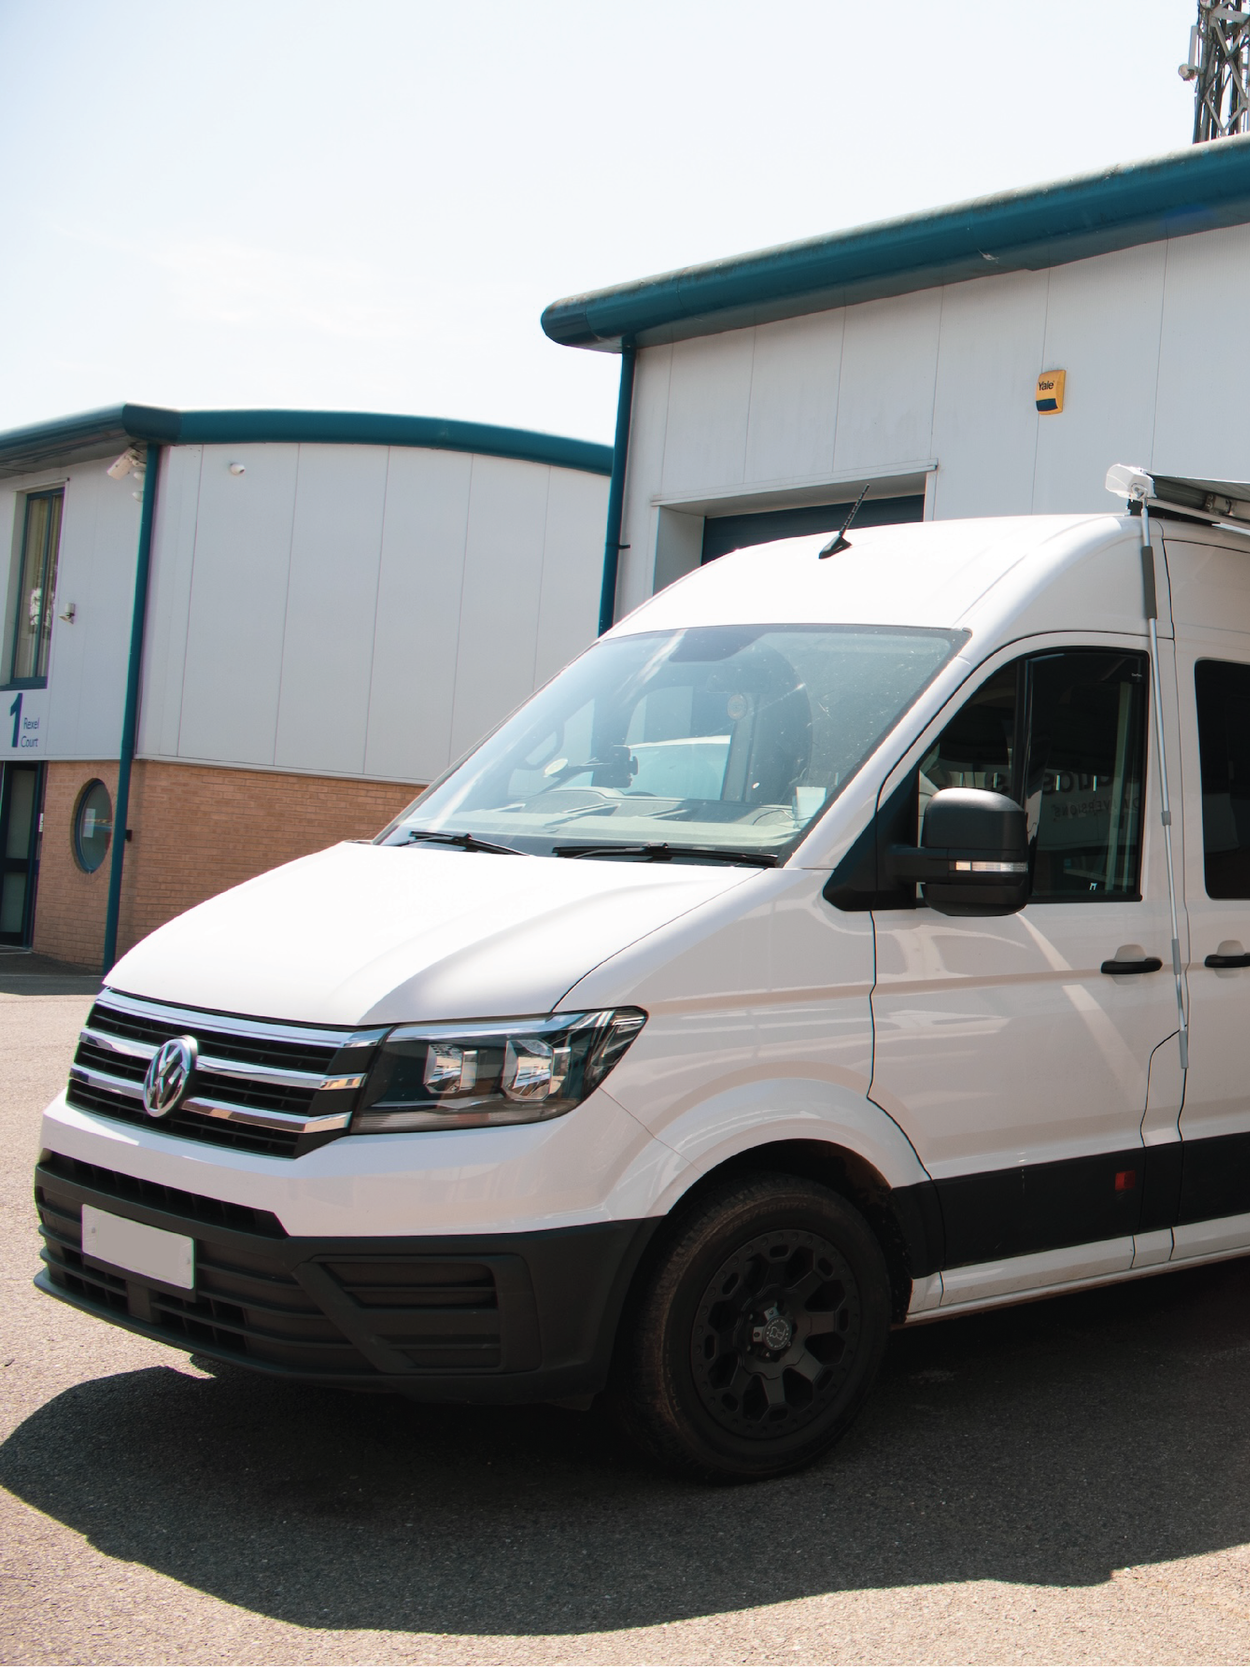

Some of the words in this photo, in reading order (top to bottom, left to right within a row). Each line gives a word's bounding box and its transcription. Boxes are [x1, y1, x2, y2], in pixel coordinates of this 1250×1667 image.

[1038, 381, 1054, 391] Yale
[10, 693, 23, 748] 1
[23, 717, 40, 730] Rexel
[21, 735, 38, 748] Court
